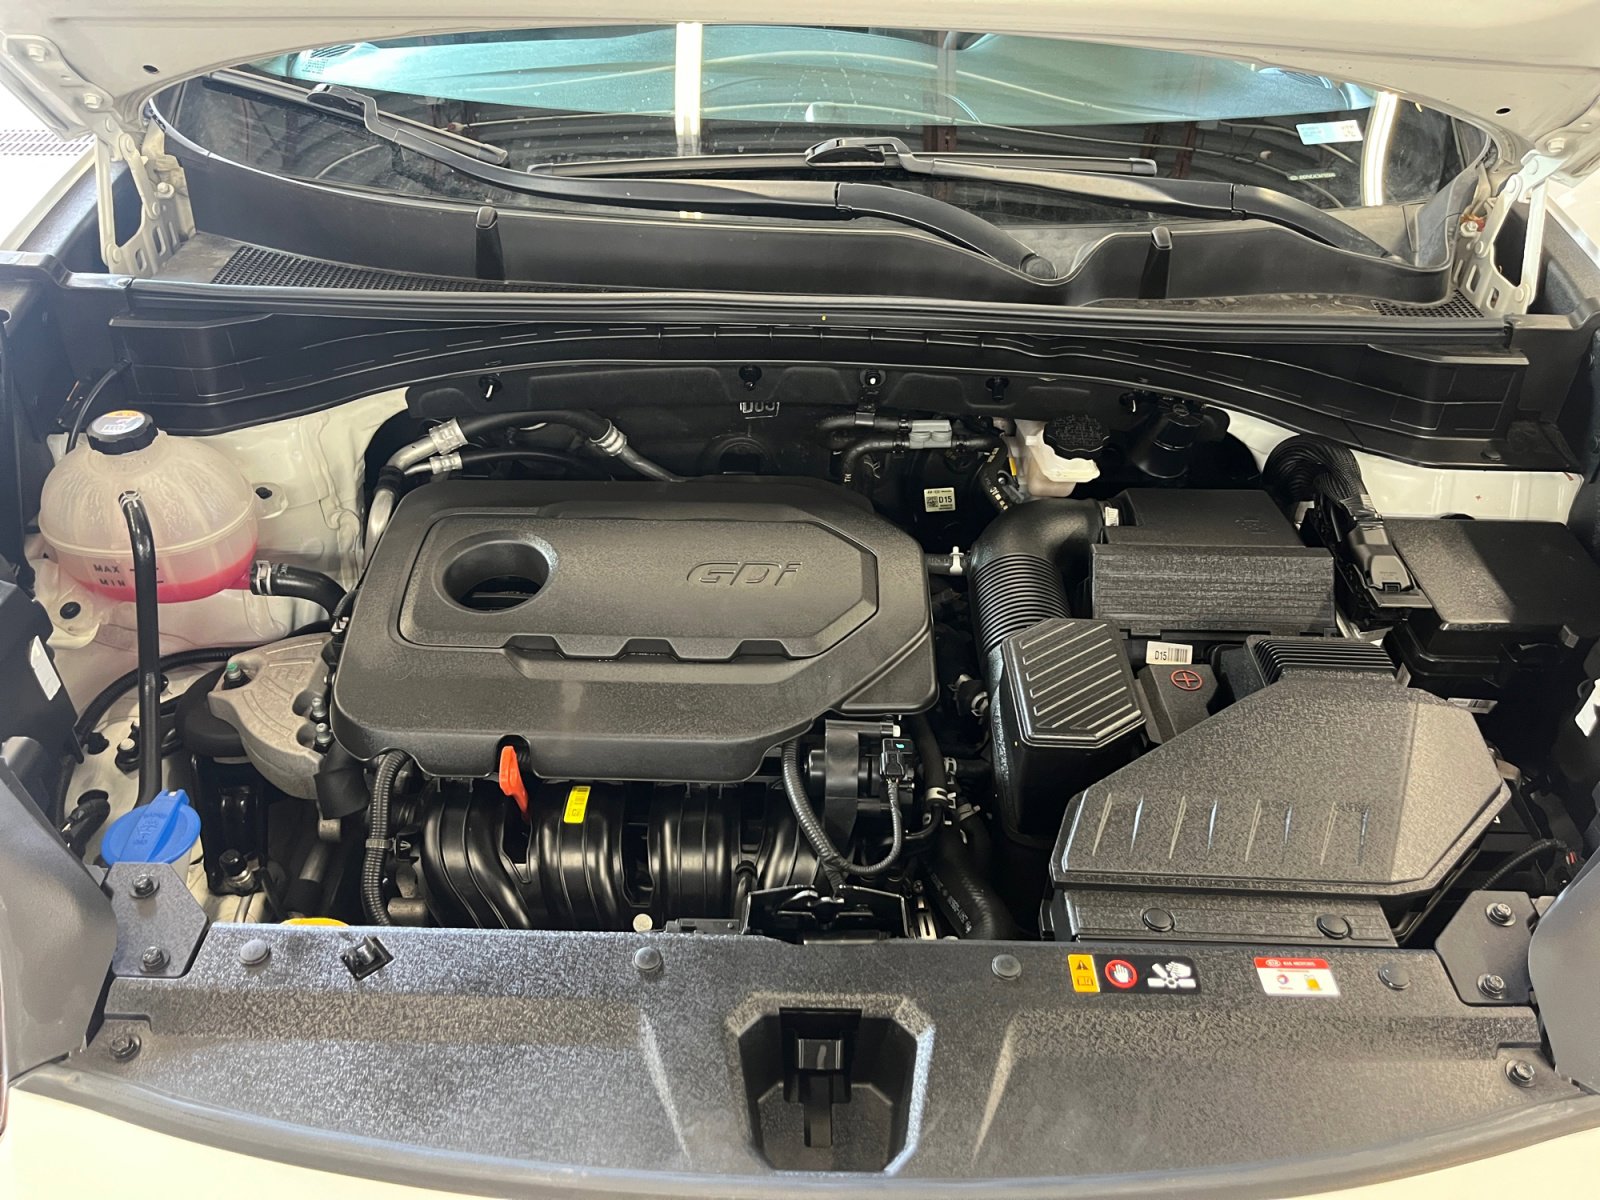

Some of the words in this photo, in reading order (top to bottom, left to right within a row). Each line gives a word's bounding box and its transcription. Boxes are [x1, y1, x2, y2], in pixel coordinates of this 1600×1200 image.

[938, 495, 953, 504] D15
[93, 564, 120, 573] MAX
[99, 578, 126, 587] MIN
[1154, 650, 1168, 661] D15
